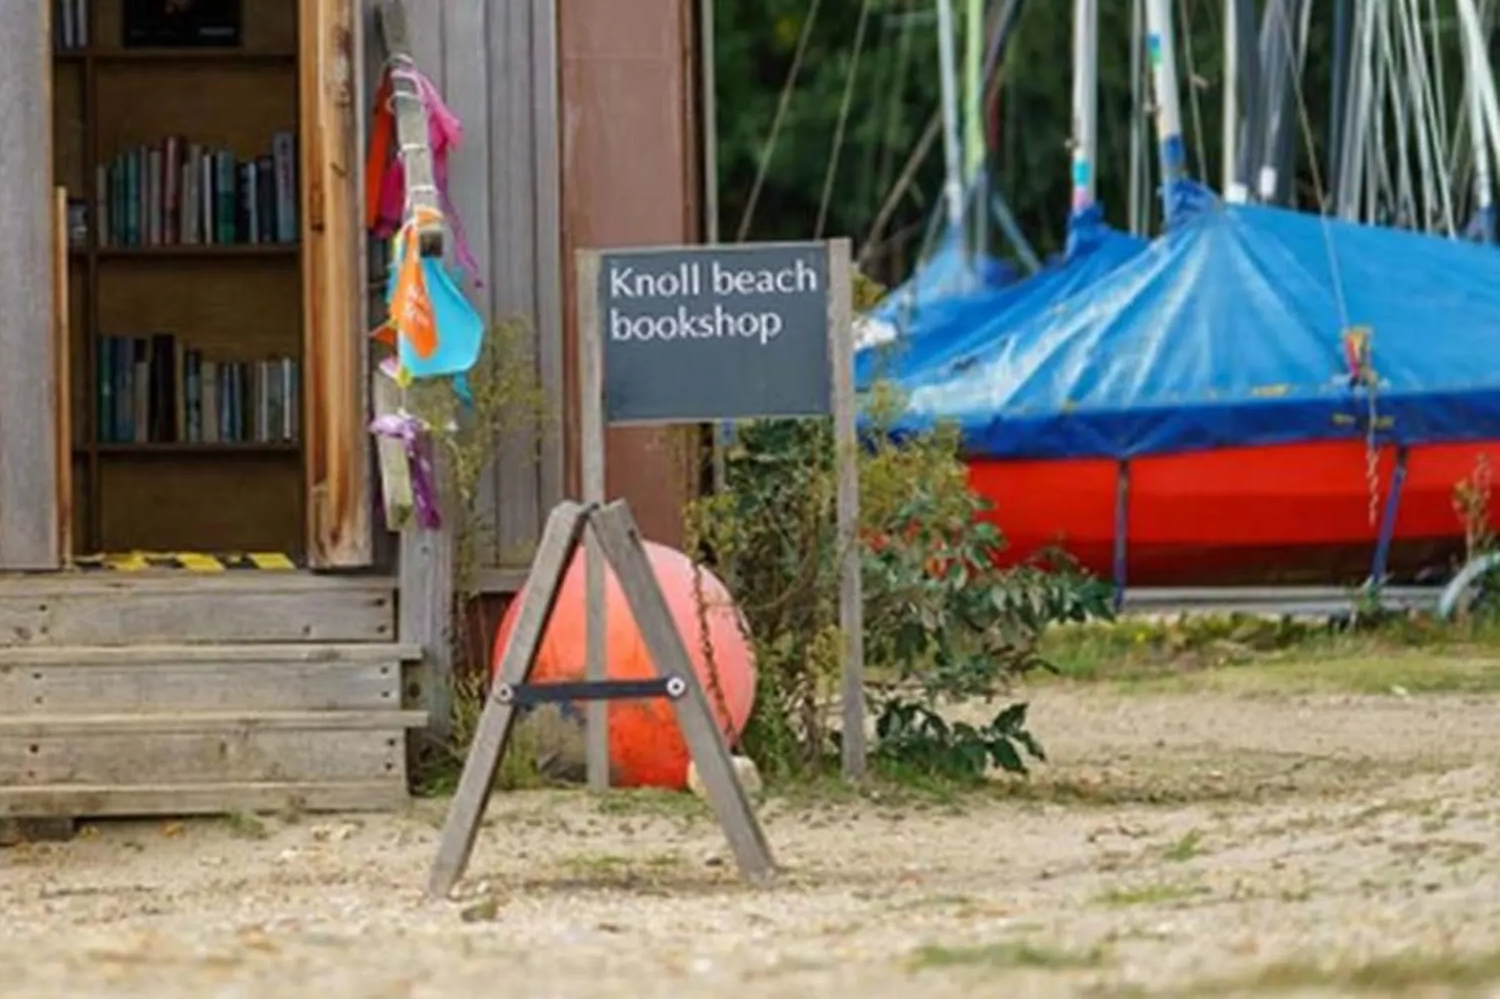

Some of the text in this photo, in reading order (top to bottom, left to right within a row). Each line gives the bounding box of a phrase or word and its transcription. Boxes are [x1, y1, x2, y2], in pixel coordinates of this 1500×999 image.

[610, 258, 818, 298] Knoll beach
[610, 304, 783, 346] bookshop
